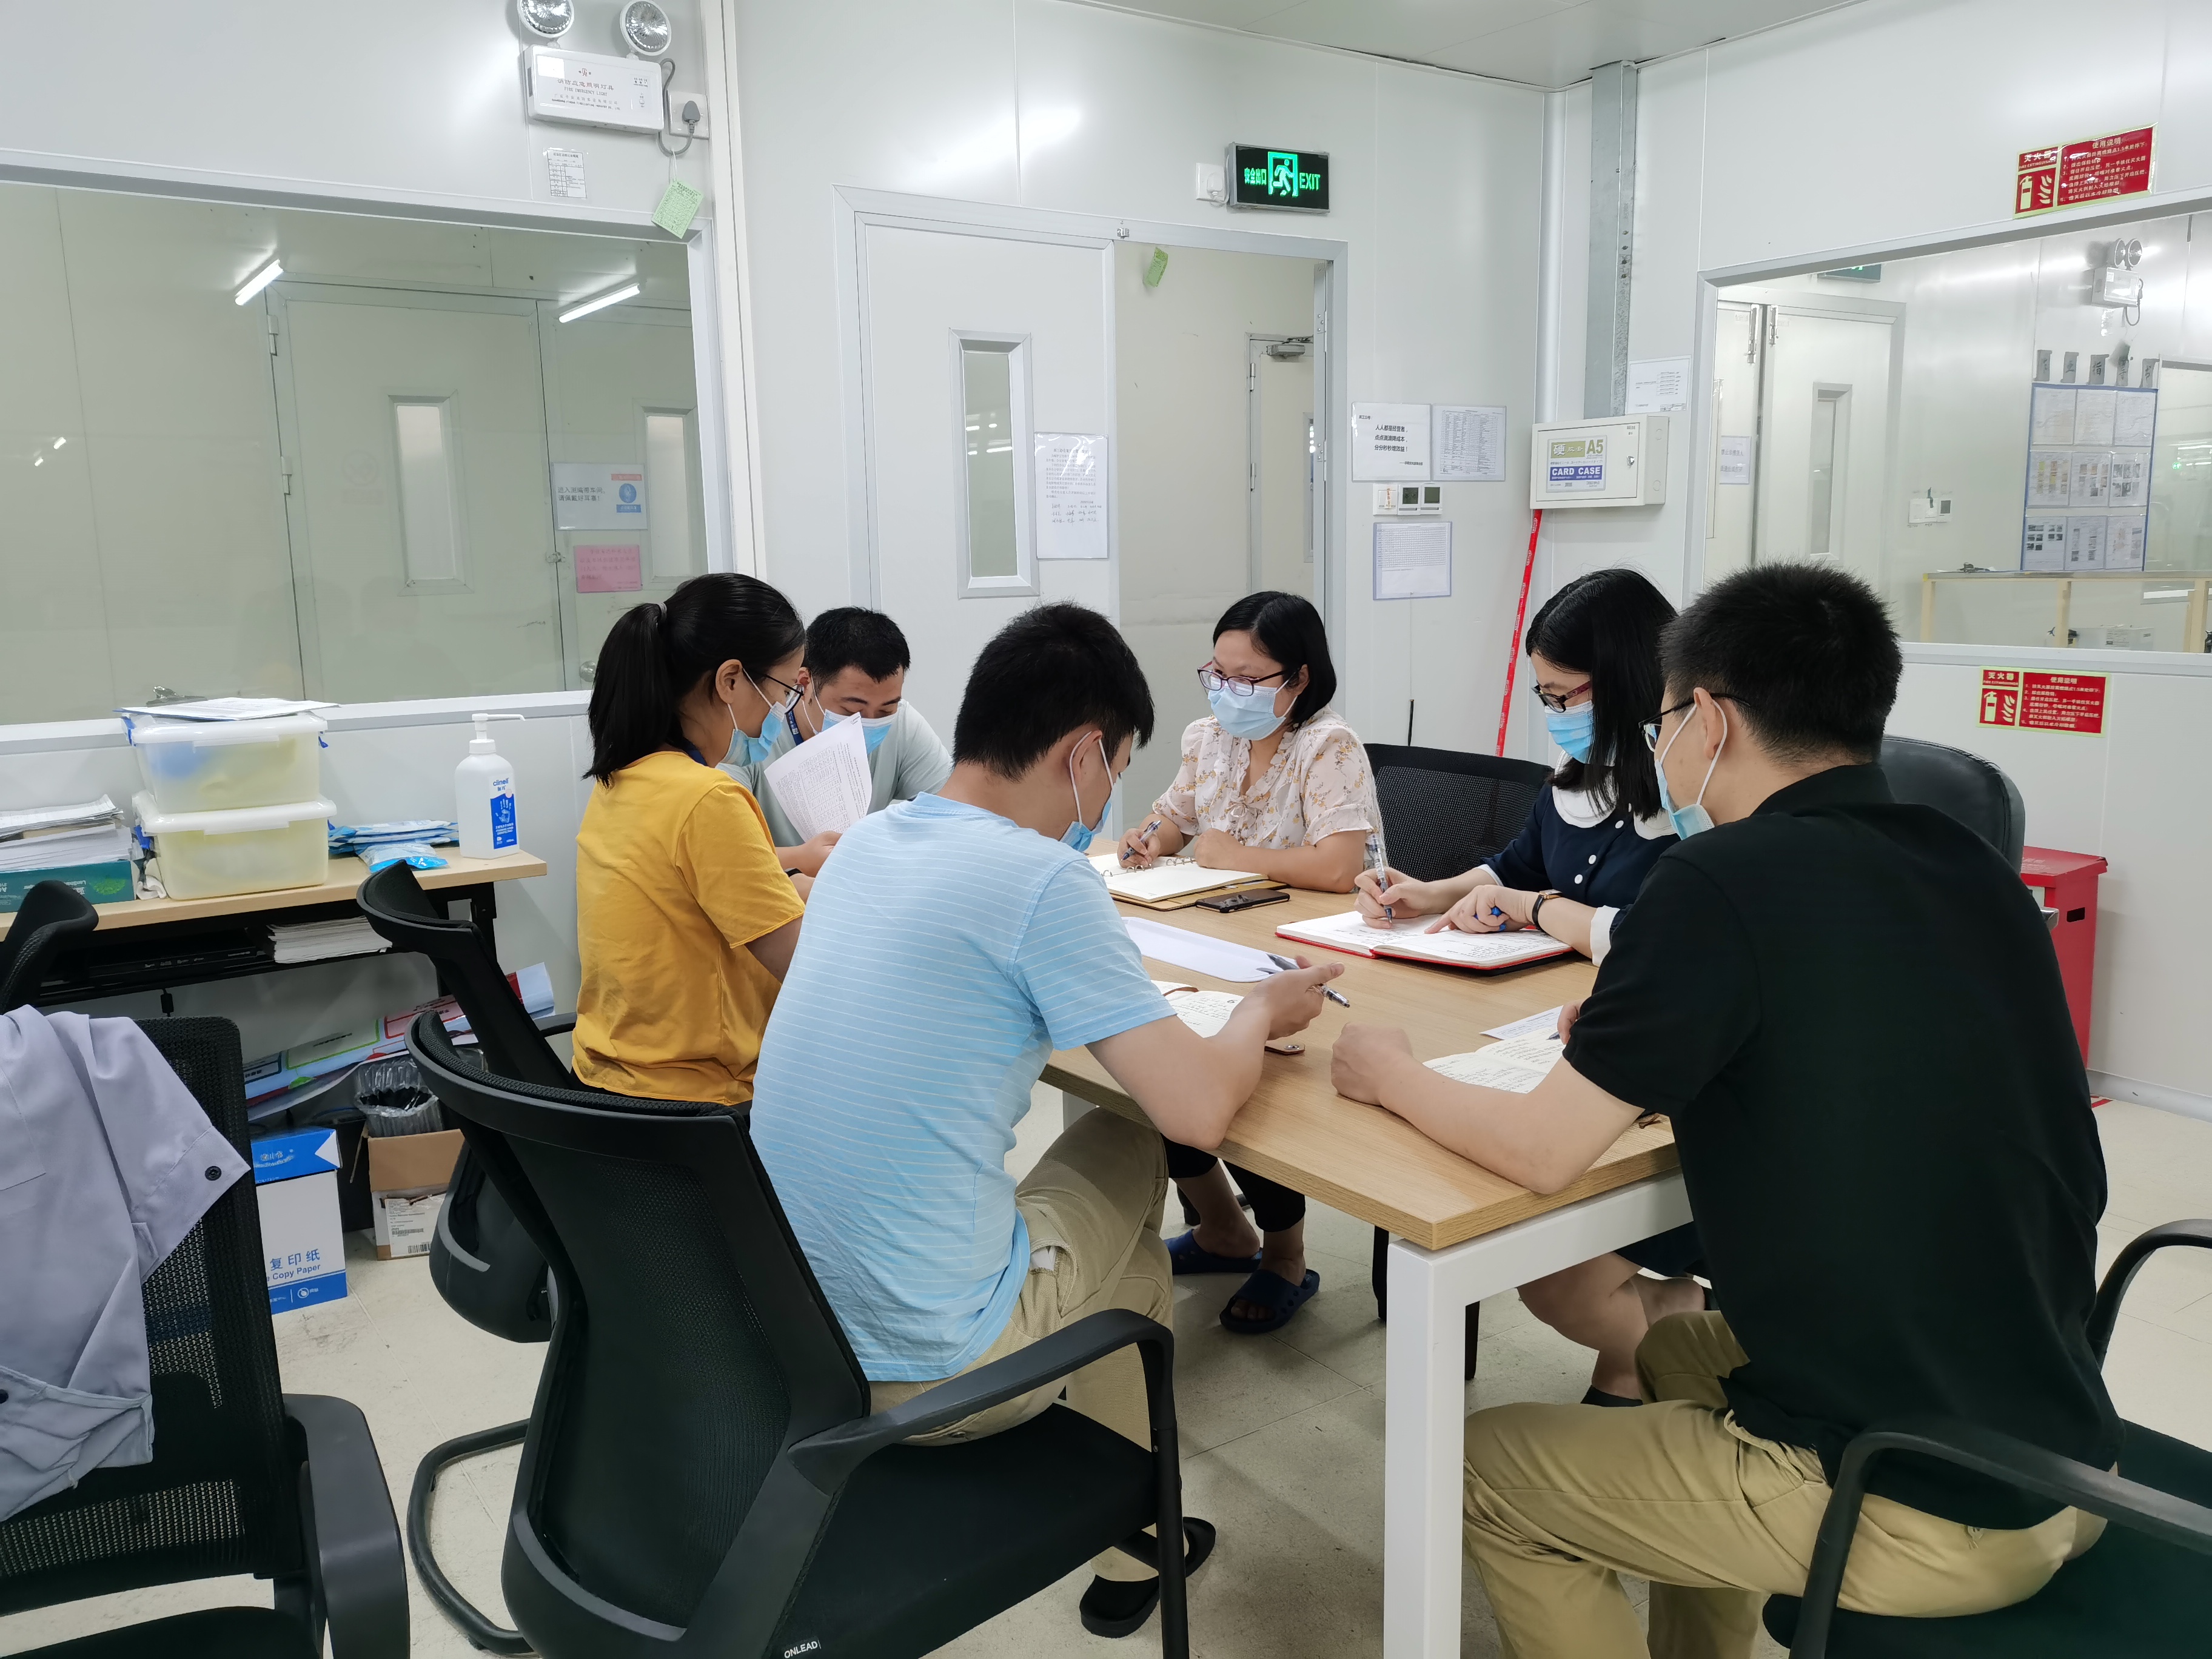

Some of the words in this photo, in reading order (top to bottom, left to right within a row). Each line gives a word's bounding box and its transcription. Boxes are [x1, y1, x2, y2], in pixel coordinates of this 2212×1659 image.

[2093, 137, 2122, 149] 使用说明
[1244, 167, 1267, 186] 安全出口
[1299, 173, 1320, 190] EXIT
[1586, 440, 1603, 454] A5
[270, 1248, 320, 1271] 复印纸
[273, 1271, 294, 1279] Copy
[297, 1264, 320, 1275] Paper
[784, 1641, 818, 1658] ONLEAD
